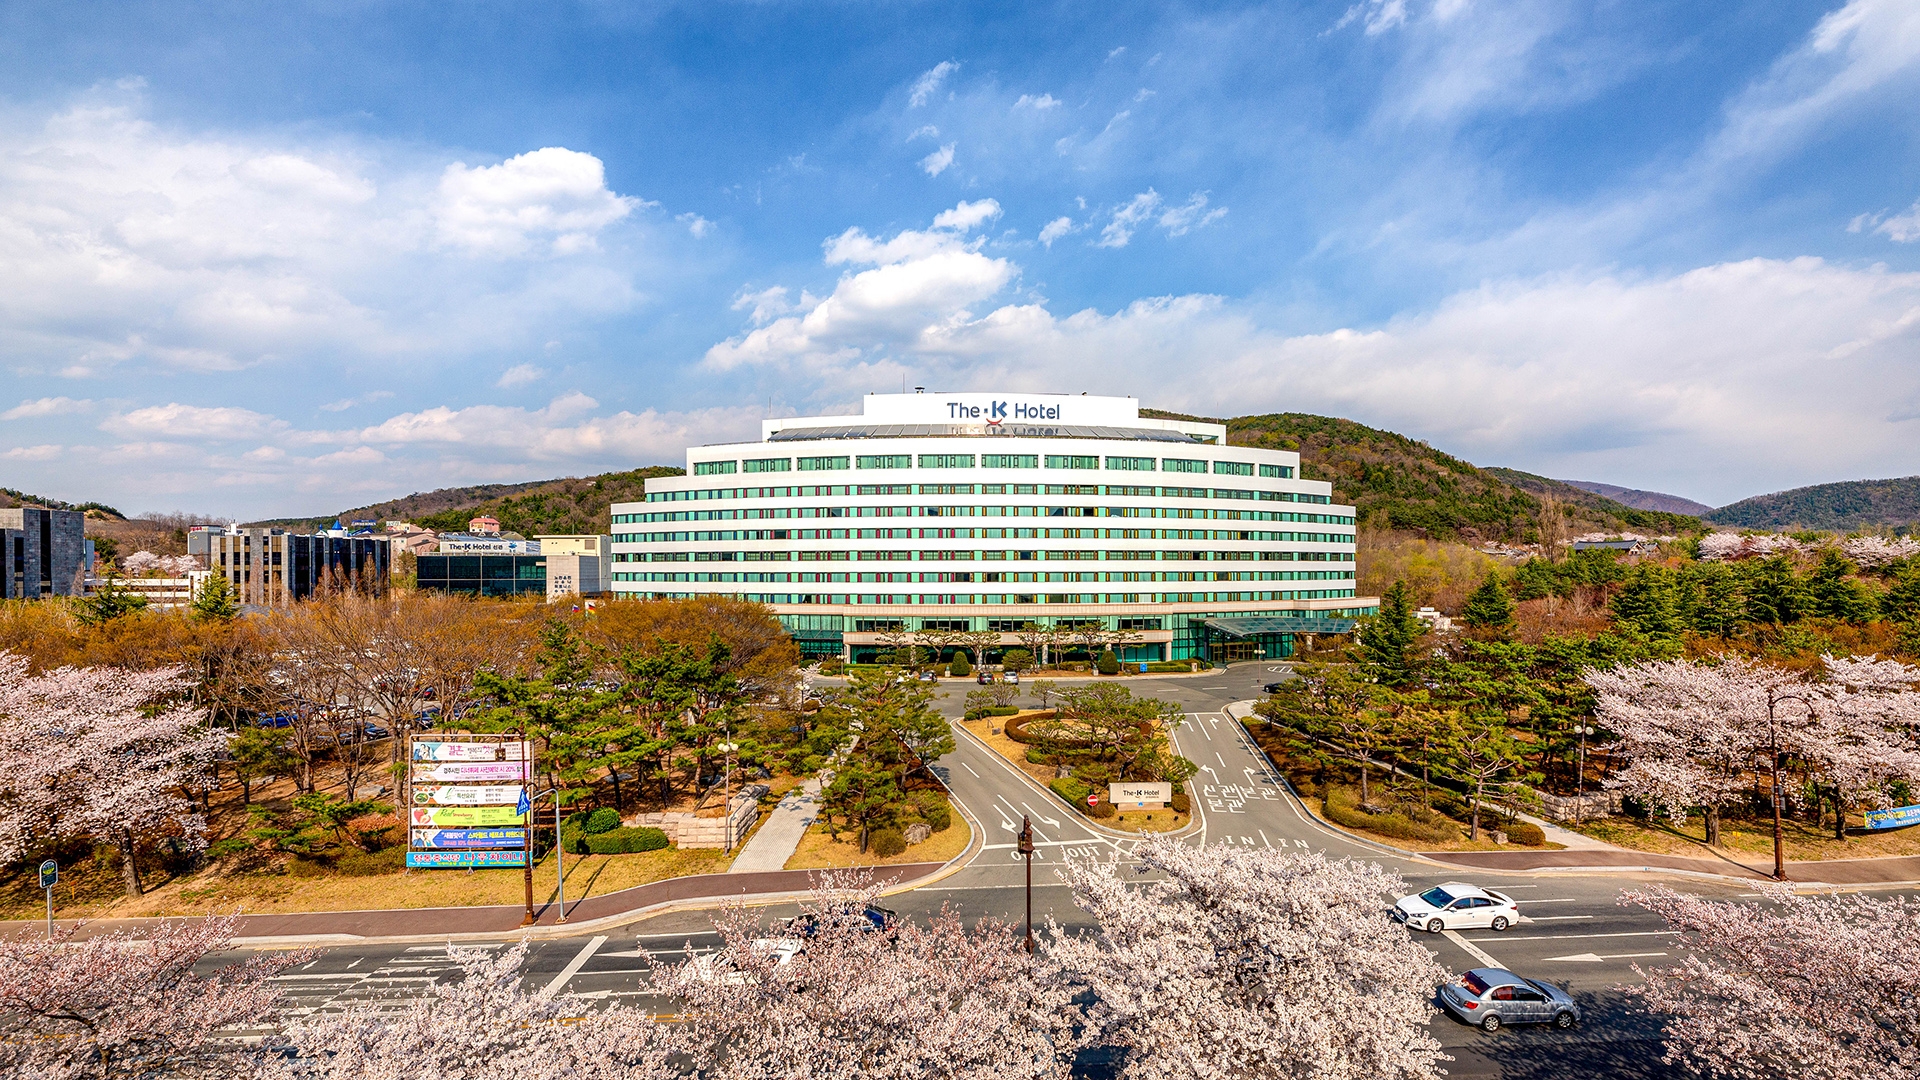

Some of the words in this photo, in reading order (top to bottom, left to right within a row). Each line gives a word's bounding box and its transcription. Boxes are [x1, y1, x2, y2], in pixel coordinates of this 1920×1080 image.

[1014, 402, 1060, 420] Hotel
[1225, 835, 1255, 846] IN
[1278, 838, 1310, 849] IN
[1066, 845, 1101, 858] OUT
